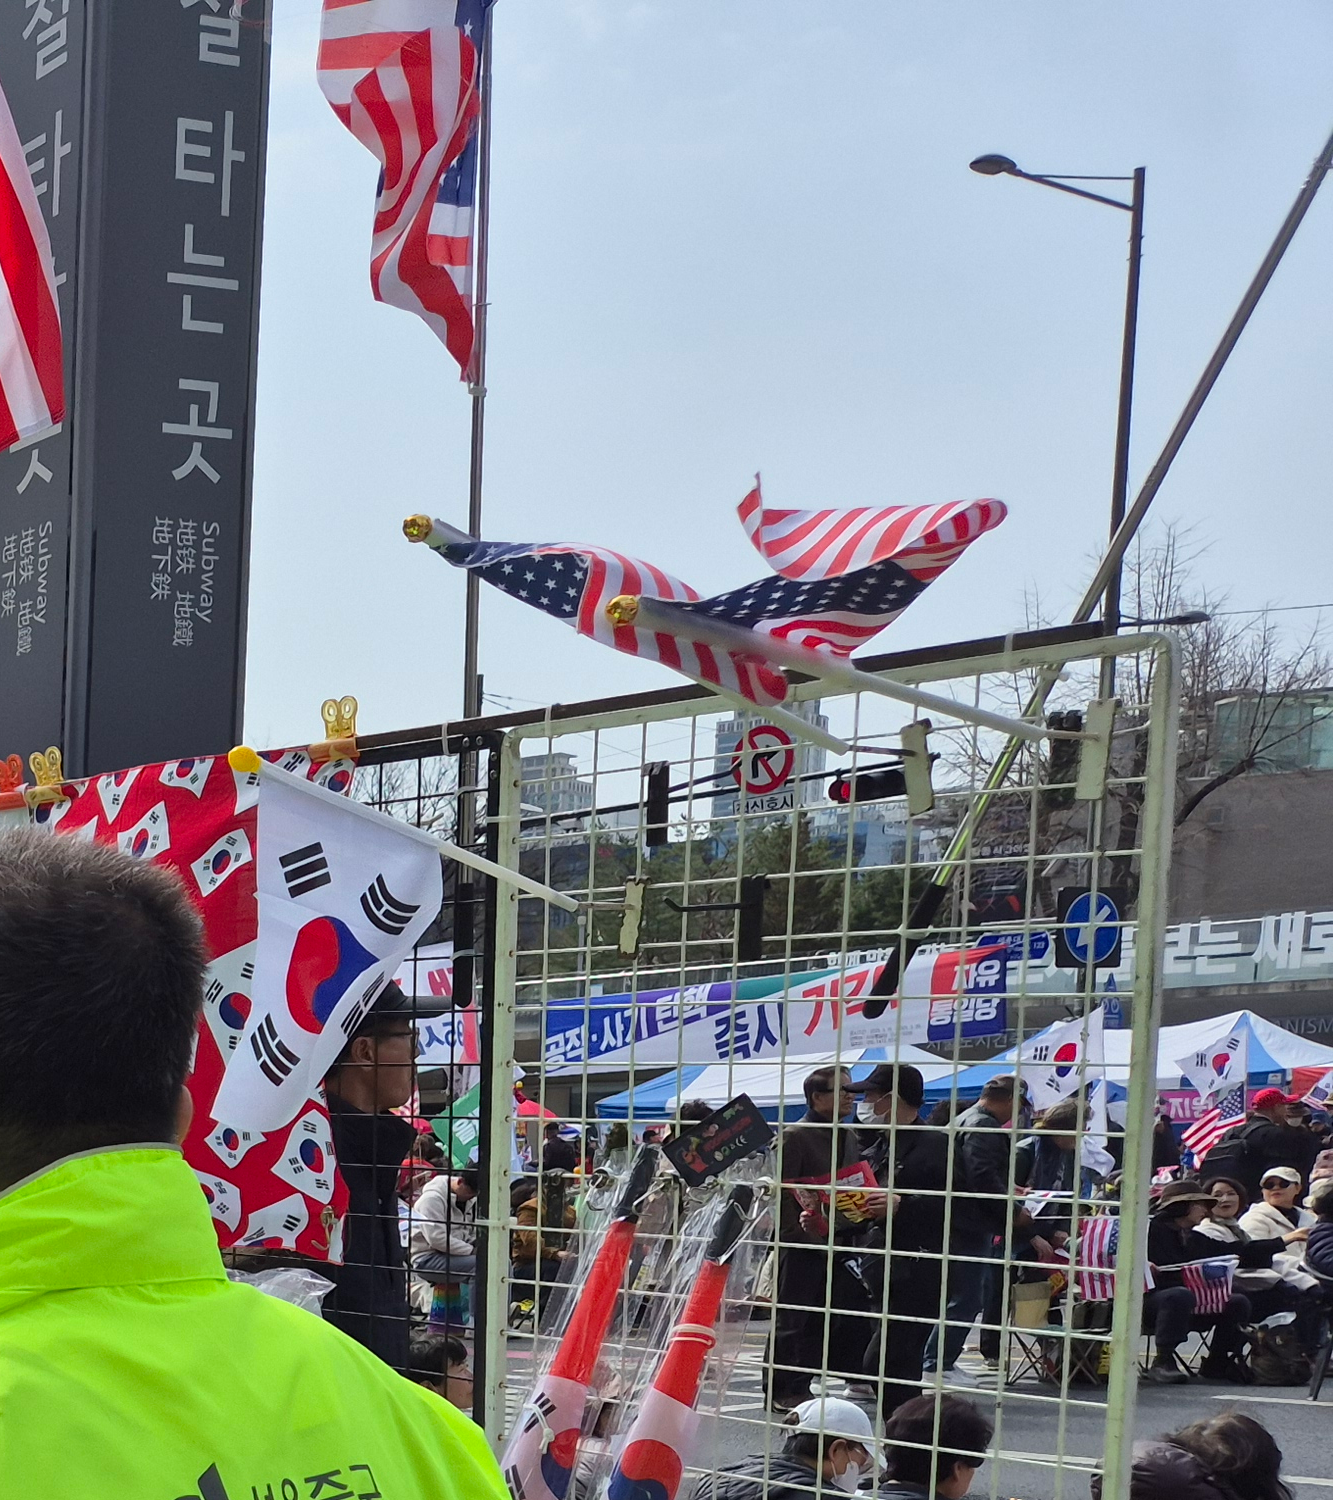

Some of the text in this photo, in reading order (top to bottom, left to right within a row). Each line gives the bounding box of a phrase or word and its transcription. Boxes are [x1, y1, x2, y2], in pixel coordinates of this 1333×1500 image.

[167, 110, 246, 334] 타는
[162, 378, 233, 485] 곳
[33, 520, 53, 625] Subway
[195, 520, 221, 624] Subway
[953, 959, 1001, 991] 자유
[714, 997, 790, 1060] 즉시
